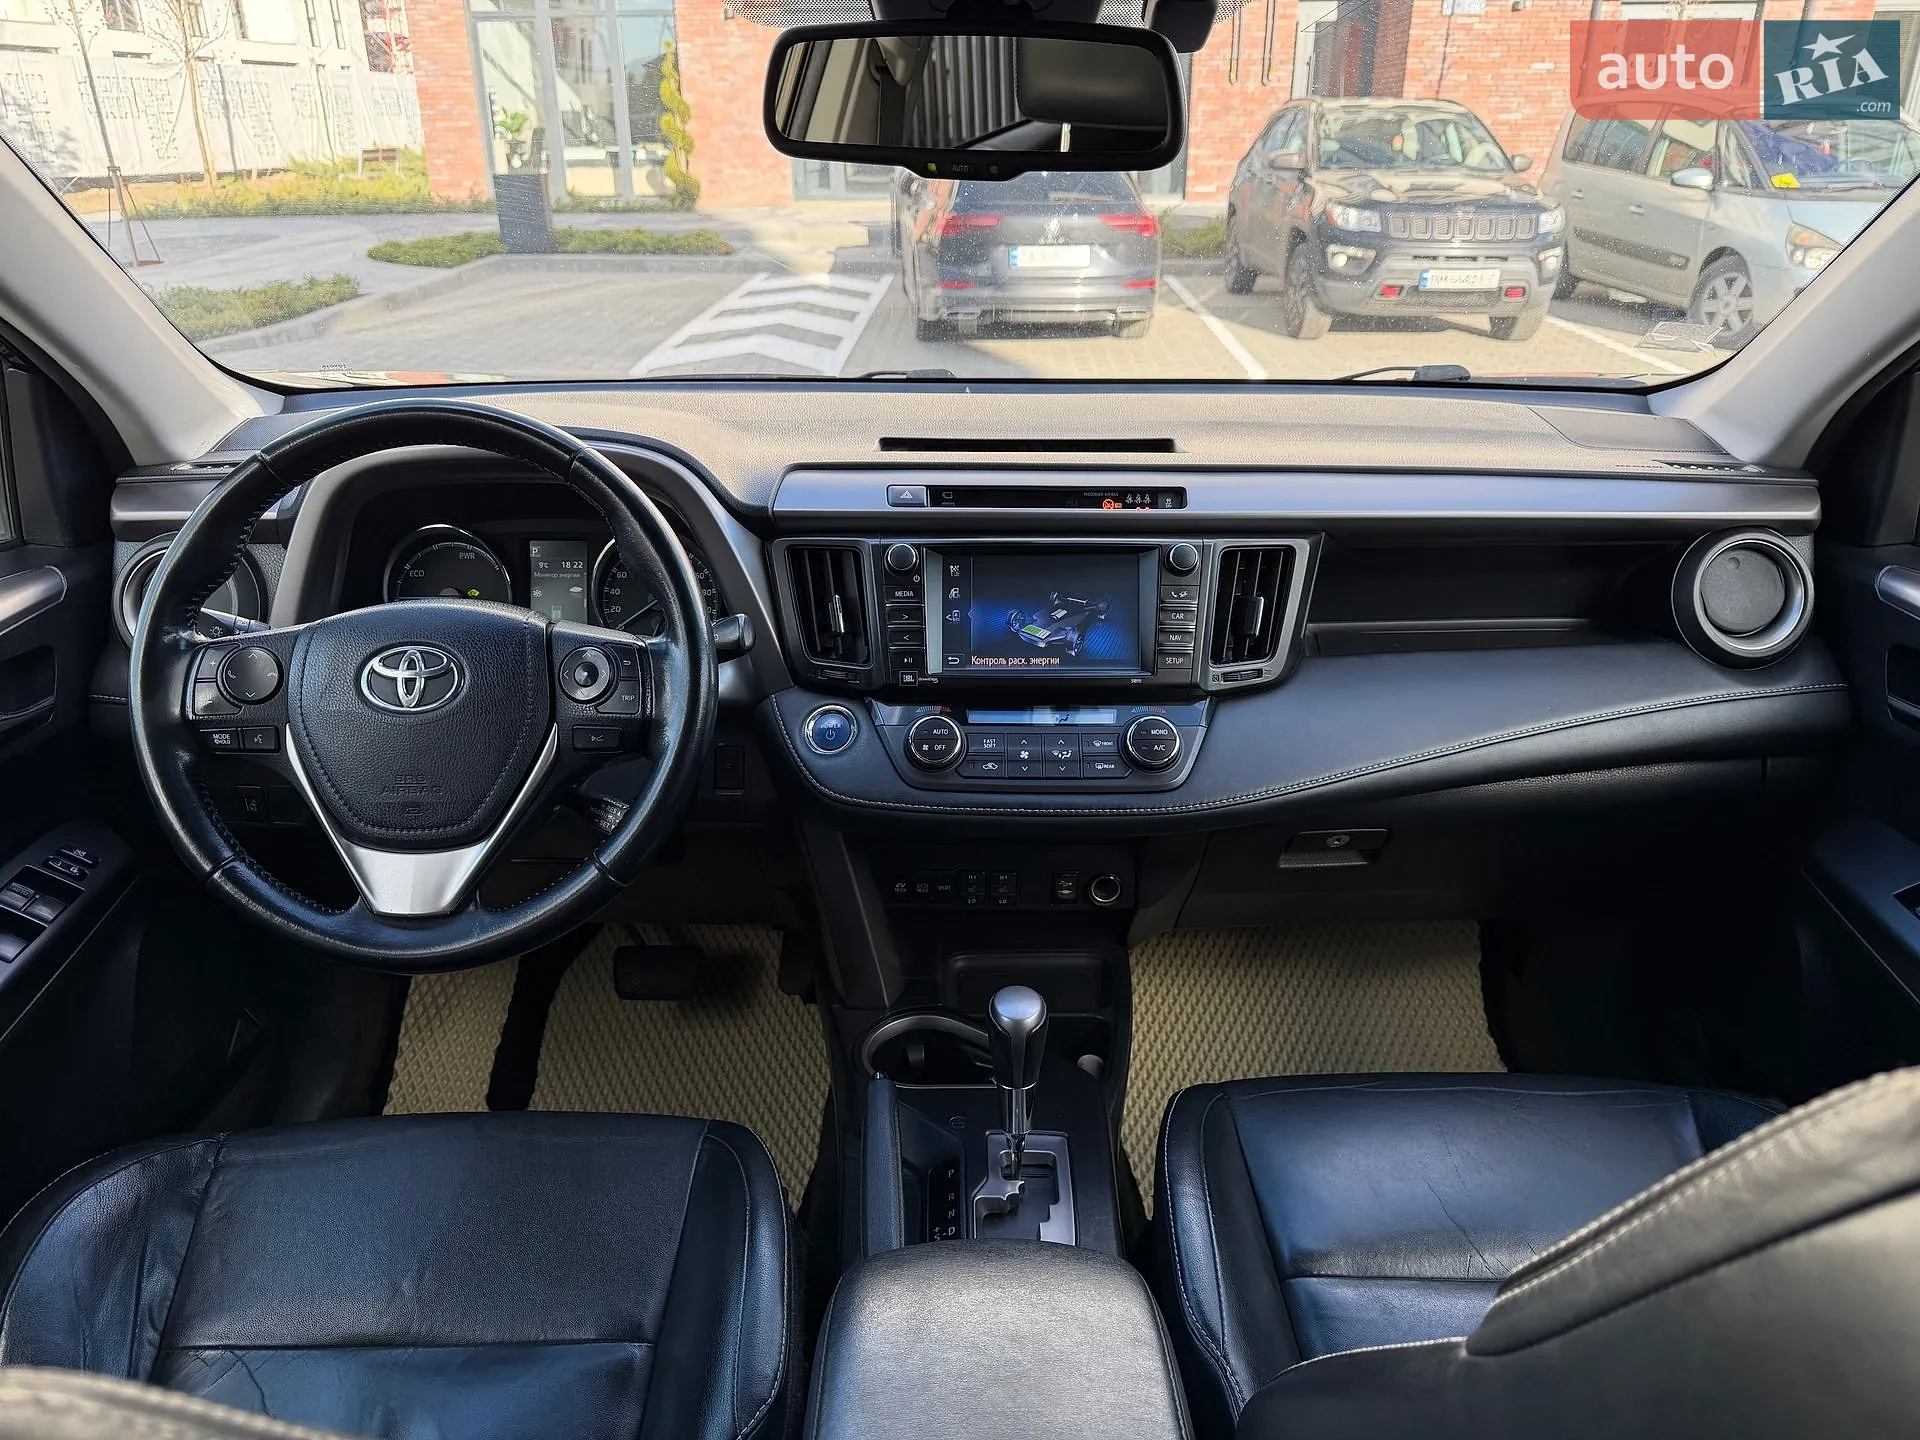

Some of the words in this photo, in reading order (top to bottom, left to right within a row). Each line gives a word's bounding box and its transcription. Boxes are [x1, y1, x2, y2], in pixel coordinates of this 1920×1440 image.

[952, 164, 969, 172] AUTO
[459, 552, 476, 560] PWR
[409, 569, 425, 578] ECO
[616, 571, 628, 579] 60
[609, 588, 621, 596] 40
[894, 590, 914, 598] MEDIA
[610, 605, 622, 613] 20
[1171, 612, 1184, 620] CAR
[971, 655, 1007, 667] Контроль
[1008, 657, 1028, 667] расх.
[1029, 657, 1060, 667] энергии
[1165, 657, 1184, 665] SETUP
[1150, 728, 1169, 736] MONO
[948, 1168, 955, 1178] P
[947, 1192, 955, 1201] R
[947, 1208, 955, 1219] N
[947, 1226, 956, 1236] D
